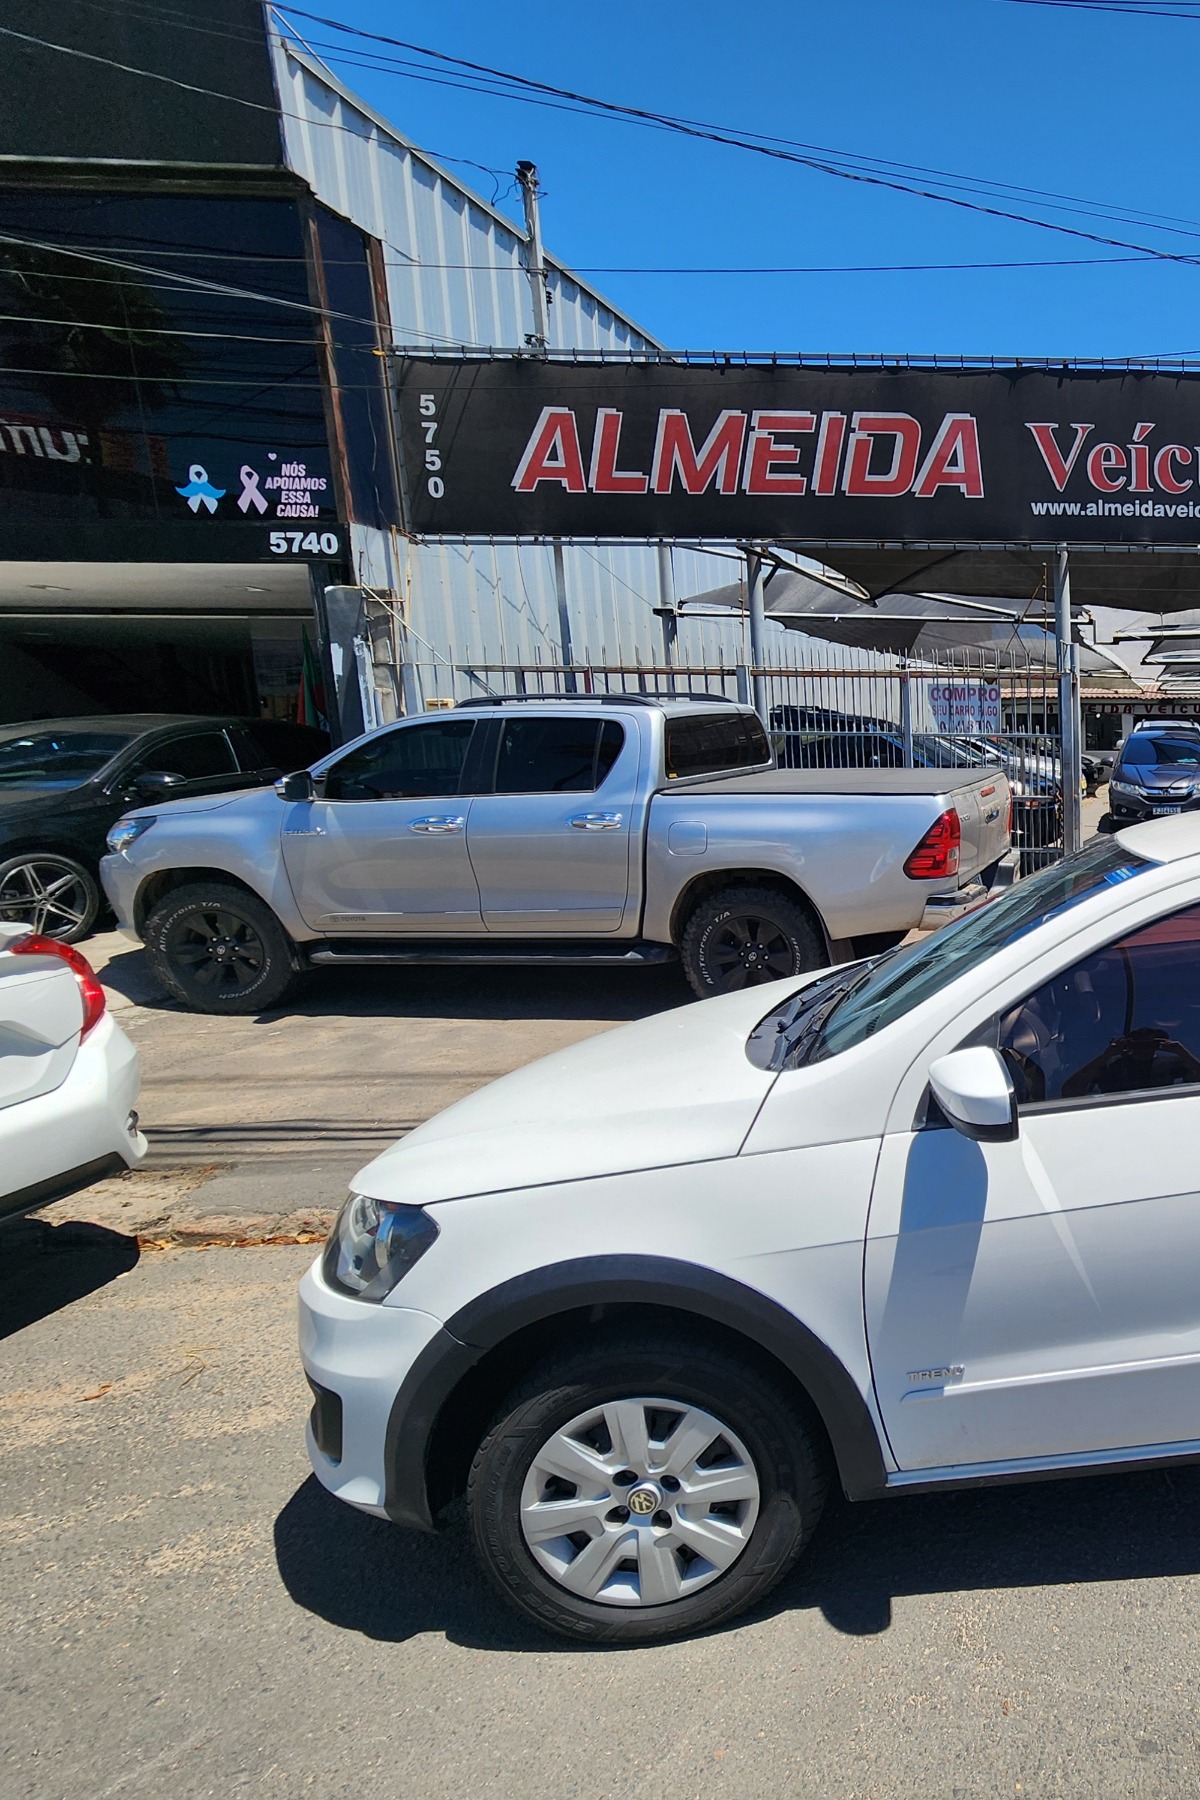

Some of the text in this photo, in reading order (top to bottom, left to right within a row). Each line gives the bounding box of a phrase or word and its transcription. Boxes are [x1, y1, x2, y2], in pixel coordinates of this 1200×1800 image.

[418, 394, 446, 499] 5750
[511, 406, 985, 499] ALMEIDA
[281, 461, 306, 476] NÓS
[265, 477, 327, 490] APOIAMOS
[281, 491, 311, 503] ESSA
[276, 505, 319, 517] CAUSA!
[269, 531, 339, 555] 5740
[930, 687, 1000, 702] COMPRO
[907, 1364, 966, 1382] TREND
